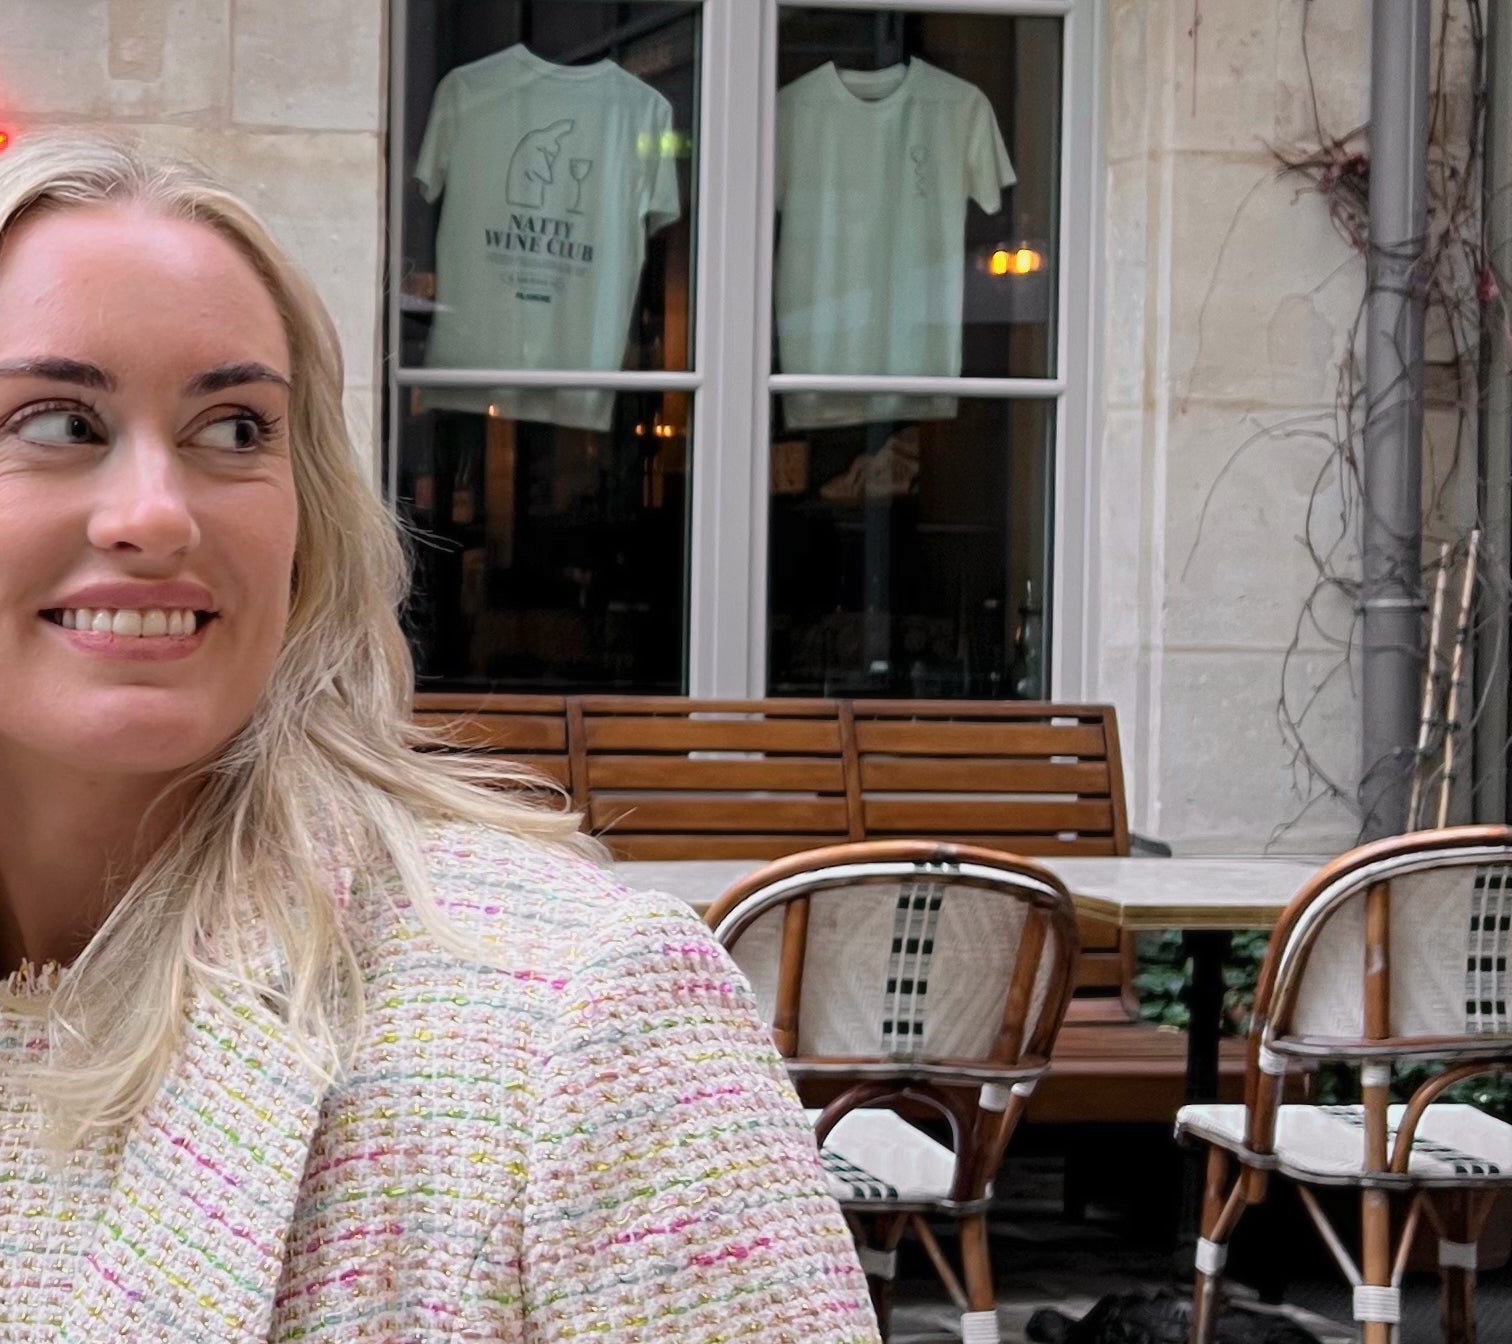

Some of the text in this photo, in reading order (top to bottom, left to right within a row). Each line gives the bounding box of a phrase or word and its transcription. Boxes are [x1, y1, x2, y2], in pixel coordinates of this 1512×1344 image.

[509, 214, 574, 238] NATTY
[485, 228, 594, 262] WINE CLUB
